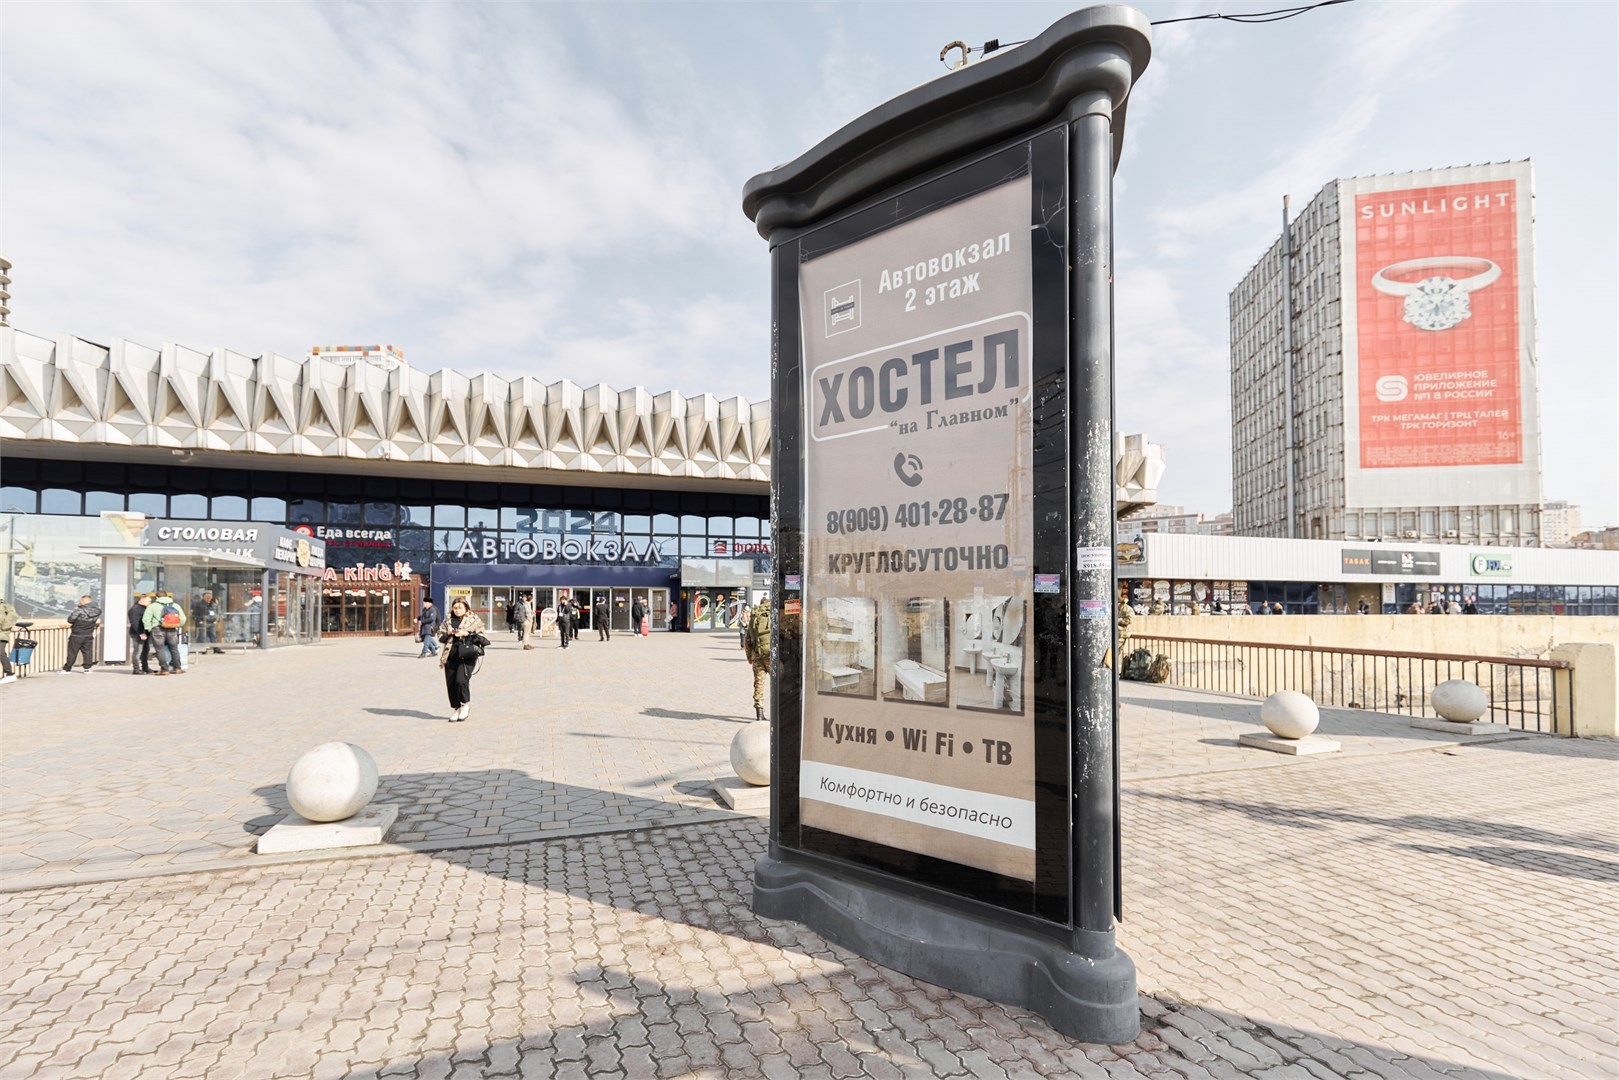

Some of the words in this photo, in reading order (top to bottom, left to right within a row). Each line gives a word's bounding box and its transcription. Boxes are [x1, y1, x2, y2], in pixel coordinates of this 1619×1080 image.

[1361, 192, 1510, 220] SUNLIGHT
[879, 232, 1011, 294] Автовокзал
[904, 288, 917, 313] 2
[925, 270, 981, 307] этаж
[819, 328, 1020, 427] ХОСТЕЛ
[1414, 370, 1489, 382] ЮВЕЛИРНОЕ
[1414, 379, 1498, 391] ПРИЛОЖЕНИЕ
[1414, 392, 1431, 401] №1
[1433, 392, 1441, 400] В
[1371, 414, 1391, 423] ТРК
[1392, 412, 1442, 422] МЕГАМАГ
[1450, 411, 1472, 420] ТРЦ
[1474, 409, 1509, 420] ТАЛЕР
[1400, 422, 1420, 430] ТРК
[1422, 419, 1479, 429] ГОРИЗОНТ
[516, 507, 617, 535] 2024
[826, 504, 889, 534] 8(909)
[158, 526, 258, 541] СТОЛОВАЯ
[316, 526, 344, 539] Еда
[346, 529, 392, 541] всегда
[457, 537, 663, 563] АВТОВОКЗАЛ
[828, 544, 1009, 575] КРУГЛОСУТОЧНО
[345, 563, 392, 581] KING
[823, 717, 877, 745] Кухня
[902, 727, 927, 753] Wi
[935, 732, 954, 758] Fi
[982, 738, 1013, 767] ТВ
[820, 776, 902, 806] Комфортно
[906, 796, 916, 810] и
[919, 797, 1013, 830] безопасно
